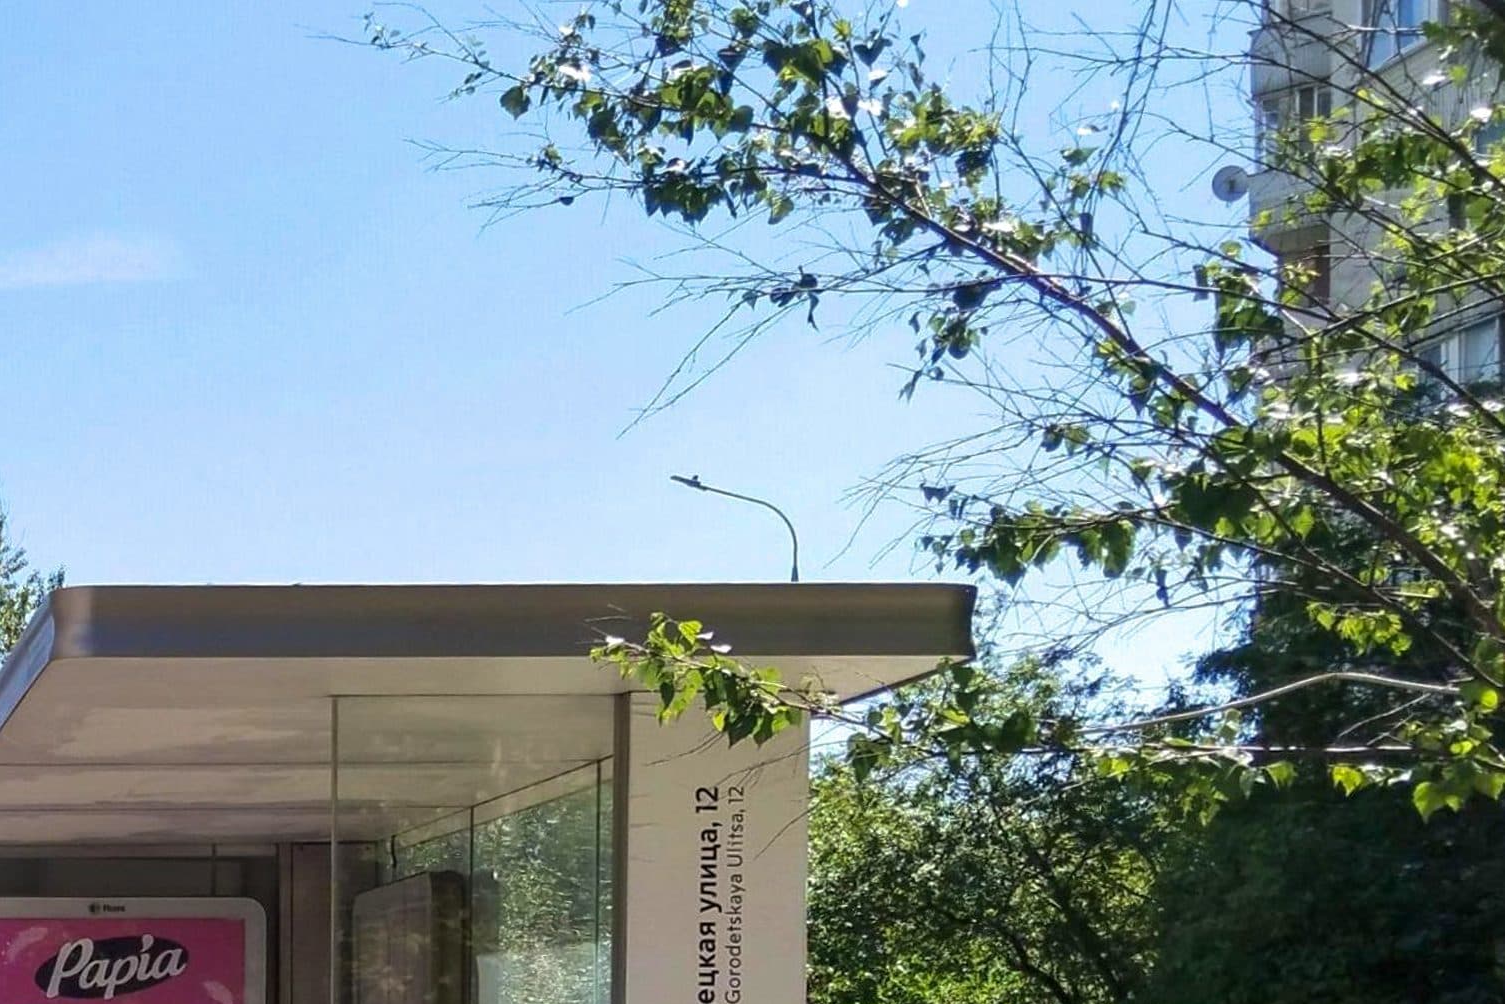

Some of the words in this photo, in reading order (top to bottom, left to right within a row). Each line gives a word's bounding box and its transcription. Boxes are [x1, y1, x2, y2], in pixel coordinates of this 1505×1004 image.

[695, 786, 719, 814] 12
[727, 786, 744, 805] 12
[699, 822, 723, 913] улица,
[726, 809, 746, 867] Ulitsa,
[47, 934, 187, 1000] Papia
[725, 873, 746, 1004] Gorodetskaya
